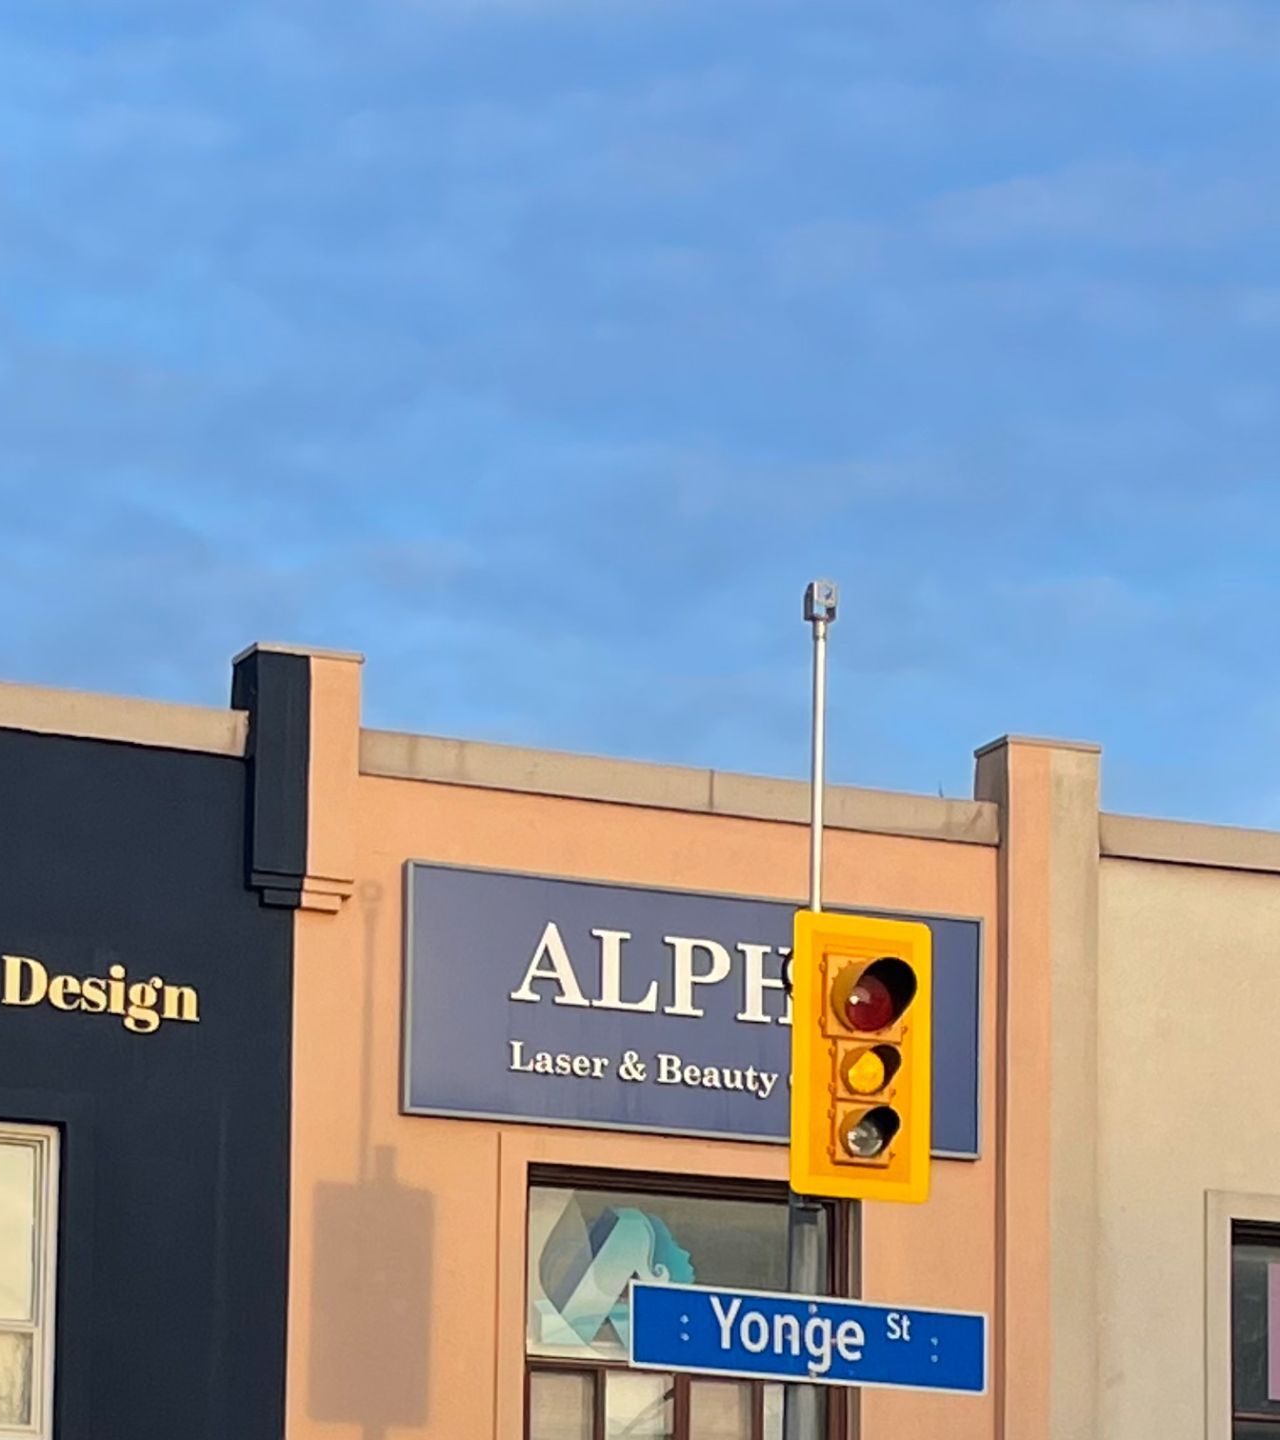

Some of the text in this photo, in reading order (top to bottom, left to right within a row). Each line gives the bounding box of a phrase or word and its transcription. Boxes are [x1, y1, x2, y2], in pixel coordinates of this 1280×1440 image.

[1, 955, 200, 1033] Design
[510, 921, 794, 1025] ALPH
[510, 1041, 778, 1099] Laser & Beauty
[709, 1295, 911, 1373] Yonge St
